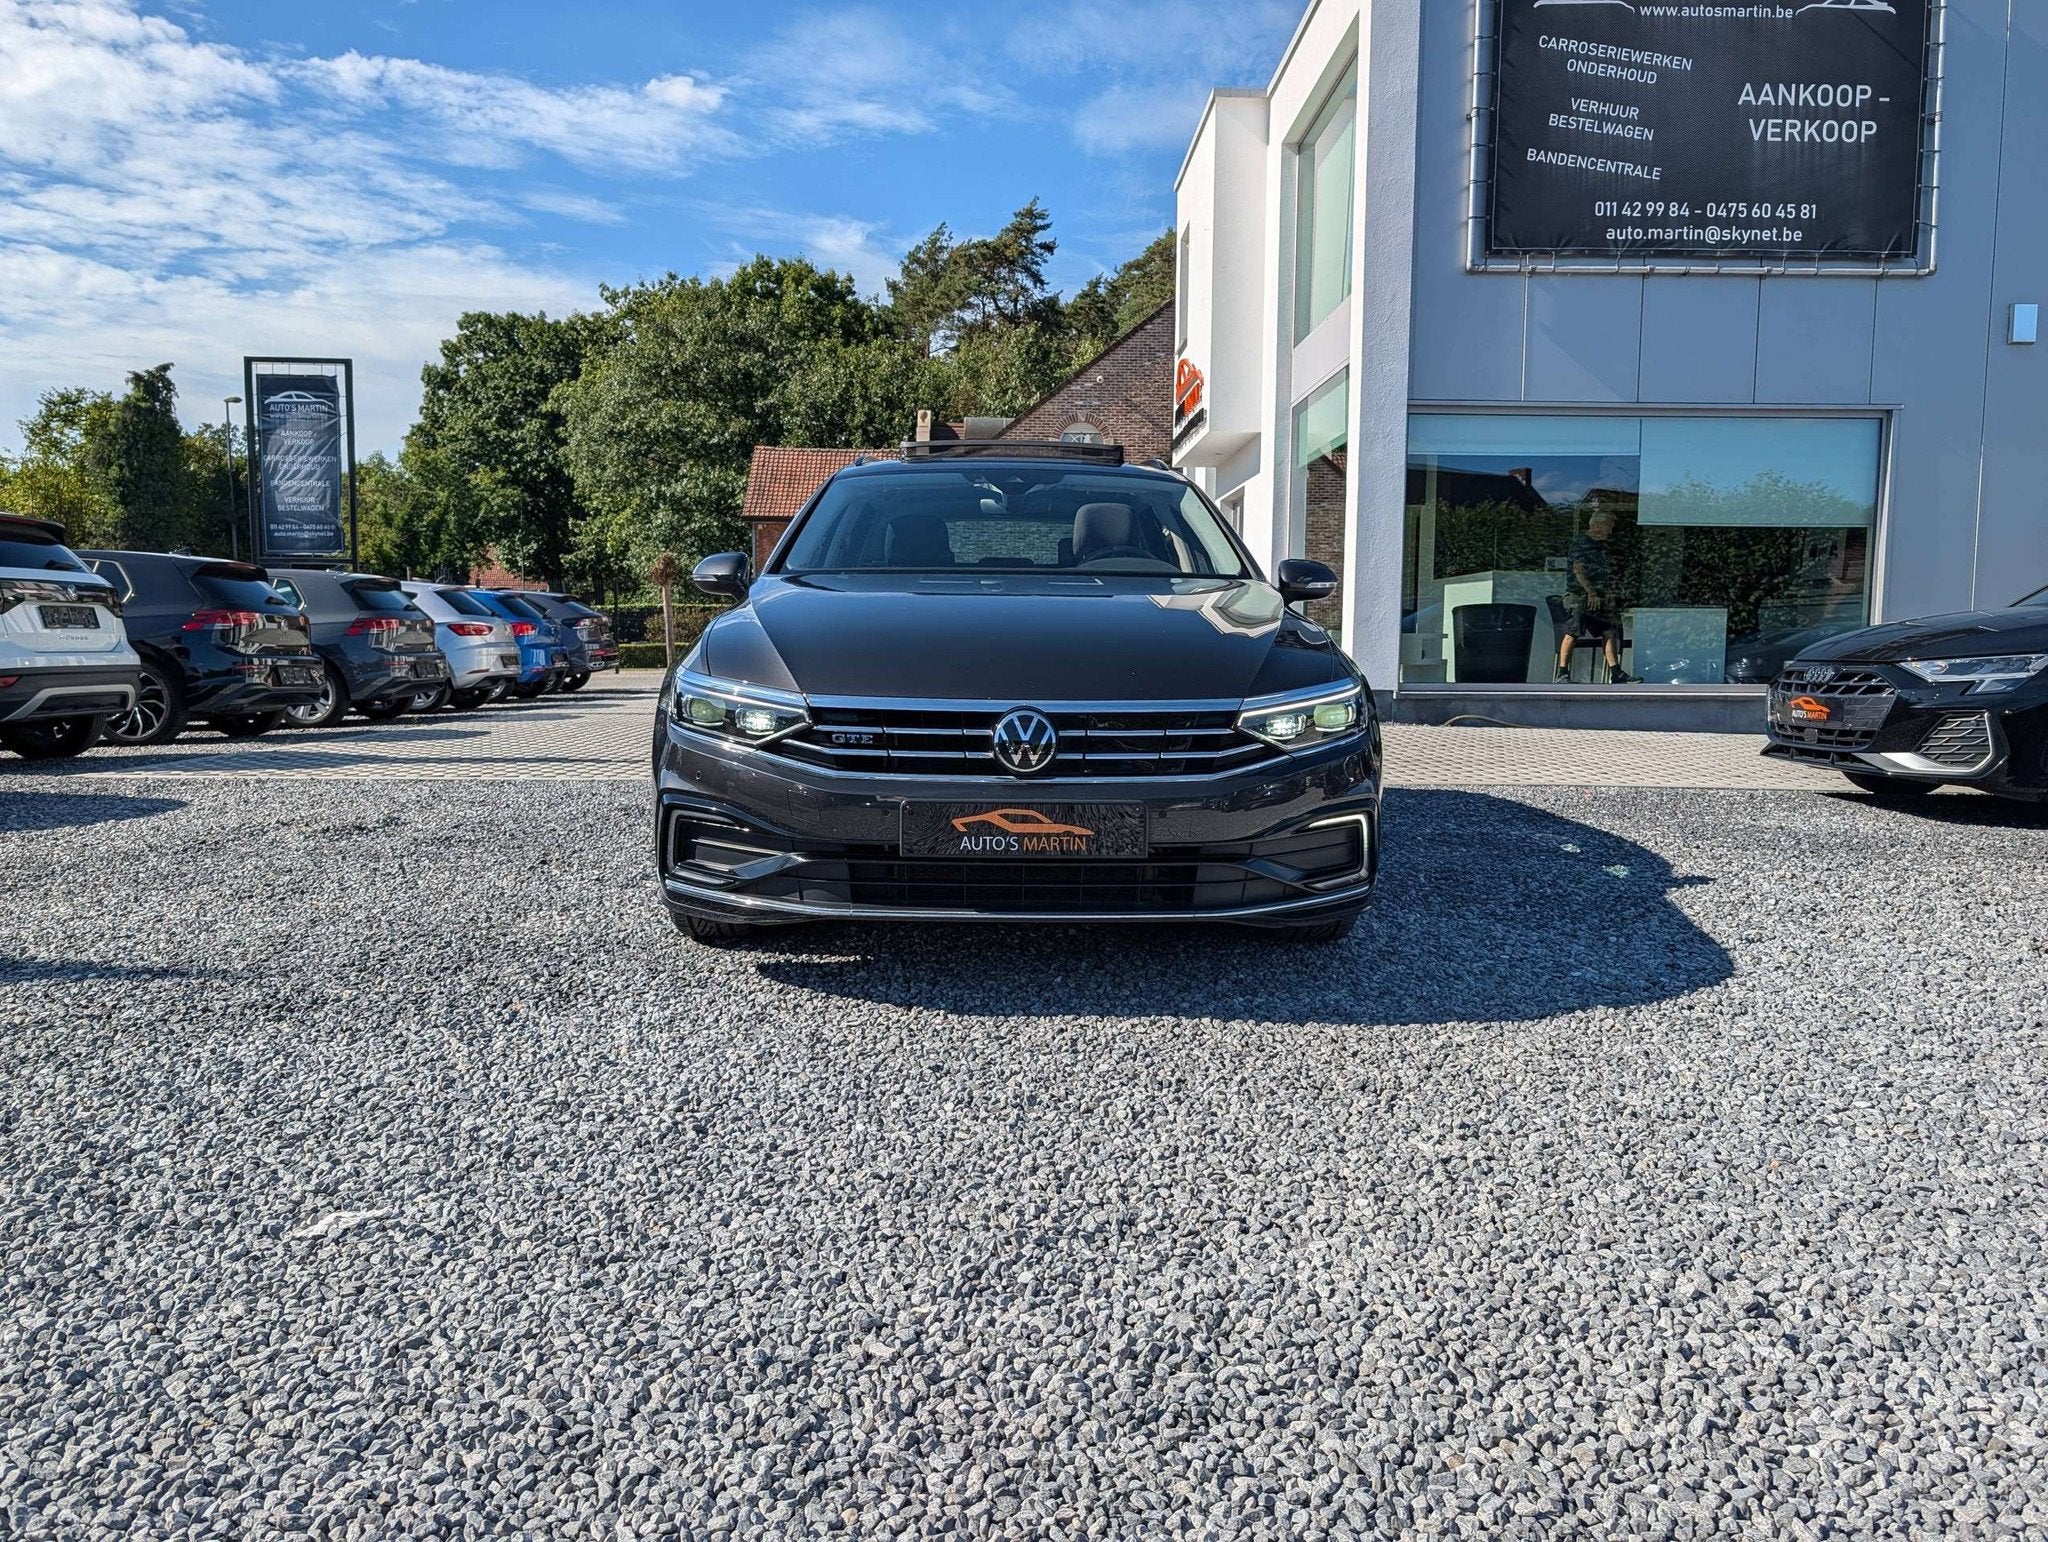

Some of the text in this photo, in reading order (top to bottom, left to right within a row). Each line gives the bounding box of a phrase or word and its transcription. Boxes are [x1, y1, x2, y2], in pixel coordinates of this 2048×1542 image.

[1640, 4, 1794, 19] www.autosmartin.be
[1538, 35, 1693, 71] CARROSERIEWERKEN
[1566, 58, 1658, 84] ONDERHOUD
[1737, 82, 1872, 108] AANKOOP
[1571, 97, 1640, 120] VERHUUR
[1548, 113, 1655, 141] BESTELWAGEN
[1748, 118, 1878, 143] VERKOOP
[1526, 148, 1663, 181] BANDENCENTRALE
[1594, 201, 1618, 217] 011
[1621, 201, 1642, 217] 42
[1645, 201, 1664, 218] 99
[1668, 202, 1690, 218] 84
[1706, 202, 1748, 219] 0475
[1751, 203, 1772, 219] 60
[1775, 203, 1796, 219] 45
[1800, 203, 1818, 220] 81
[1605, 225, 1803, 244] auto.martin@skynet.be
[269, 403, 328, 412] AUTO'S MARTIN
[831, 733, 874, 744] GTE
[959, 835, 1087, 851] AUTO'S MARTIN
